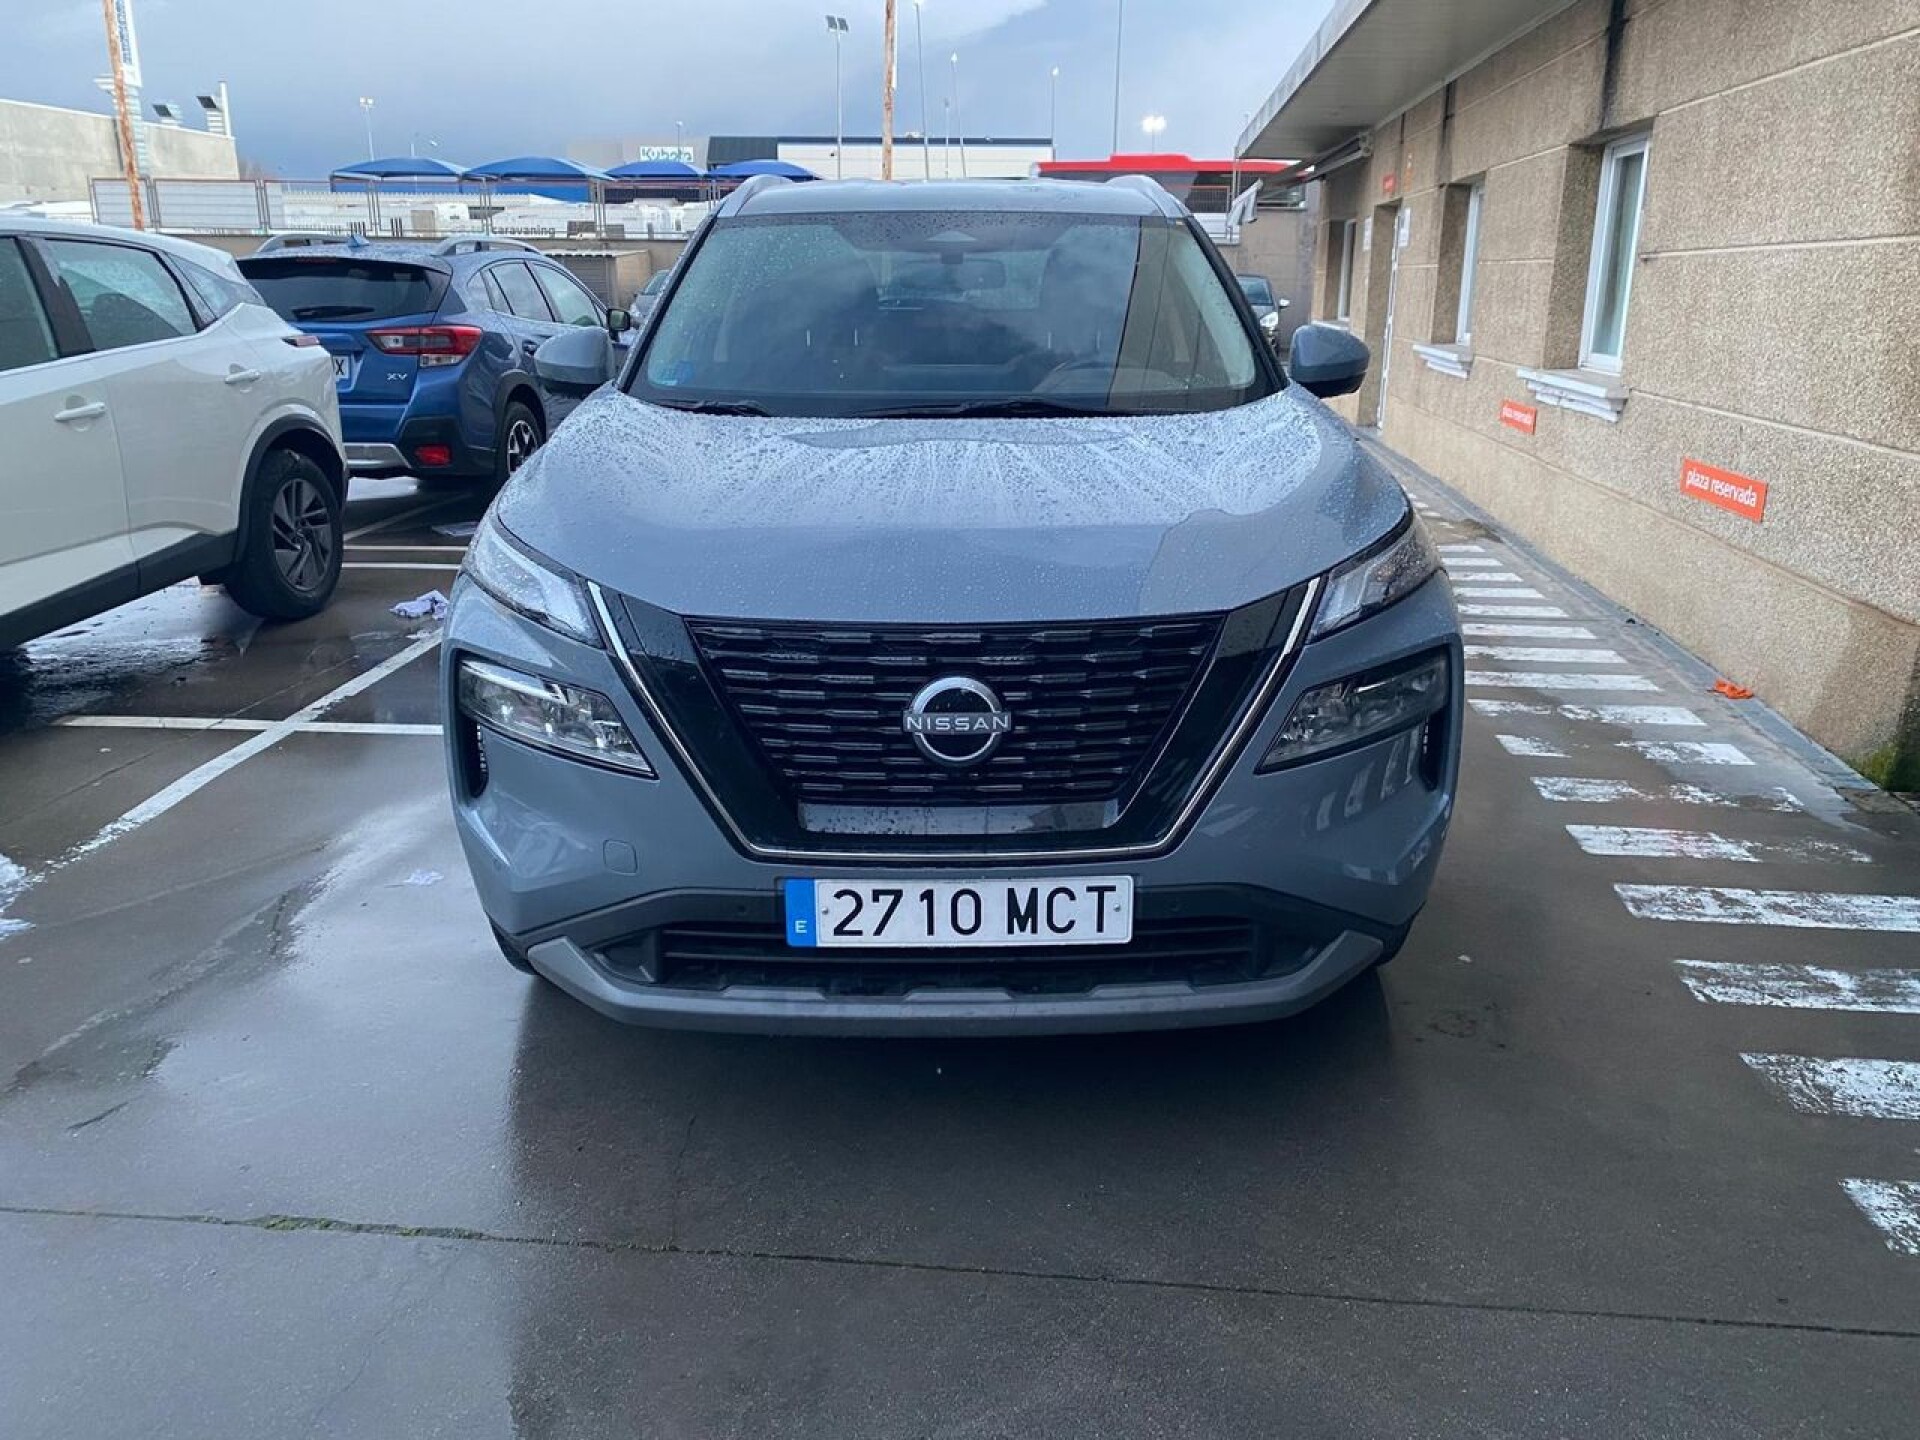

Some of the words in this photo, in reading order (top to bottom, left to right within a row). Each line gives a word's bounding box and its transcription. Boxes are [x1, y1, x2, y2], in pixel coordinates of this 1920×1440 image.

[491, 224, 556, 237] caravaning
[386, 372, 408, 382] XV
[1686, 467, 1710, 491] plaza
[1709, 471, 1757, 507] reservada
[906, 714, 1010, 731] NISSAN
[794, 920, 808, 934] E
[832, 888, 983, 937] 2710
[1006, 885, 1117, 935] MCT
